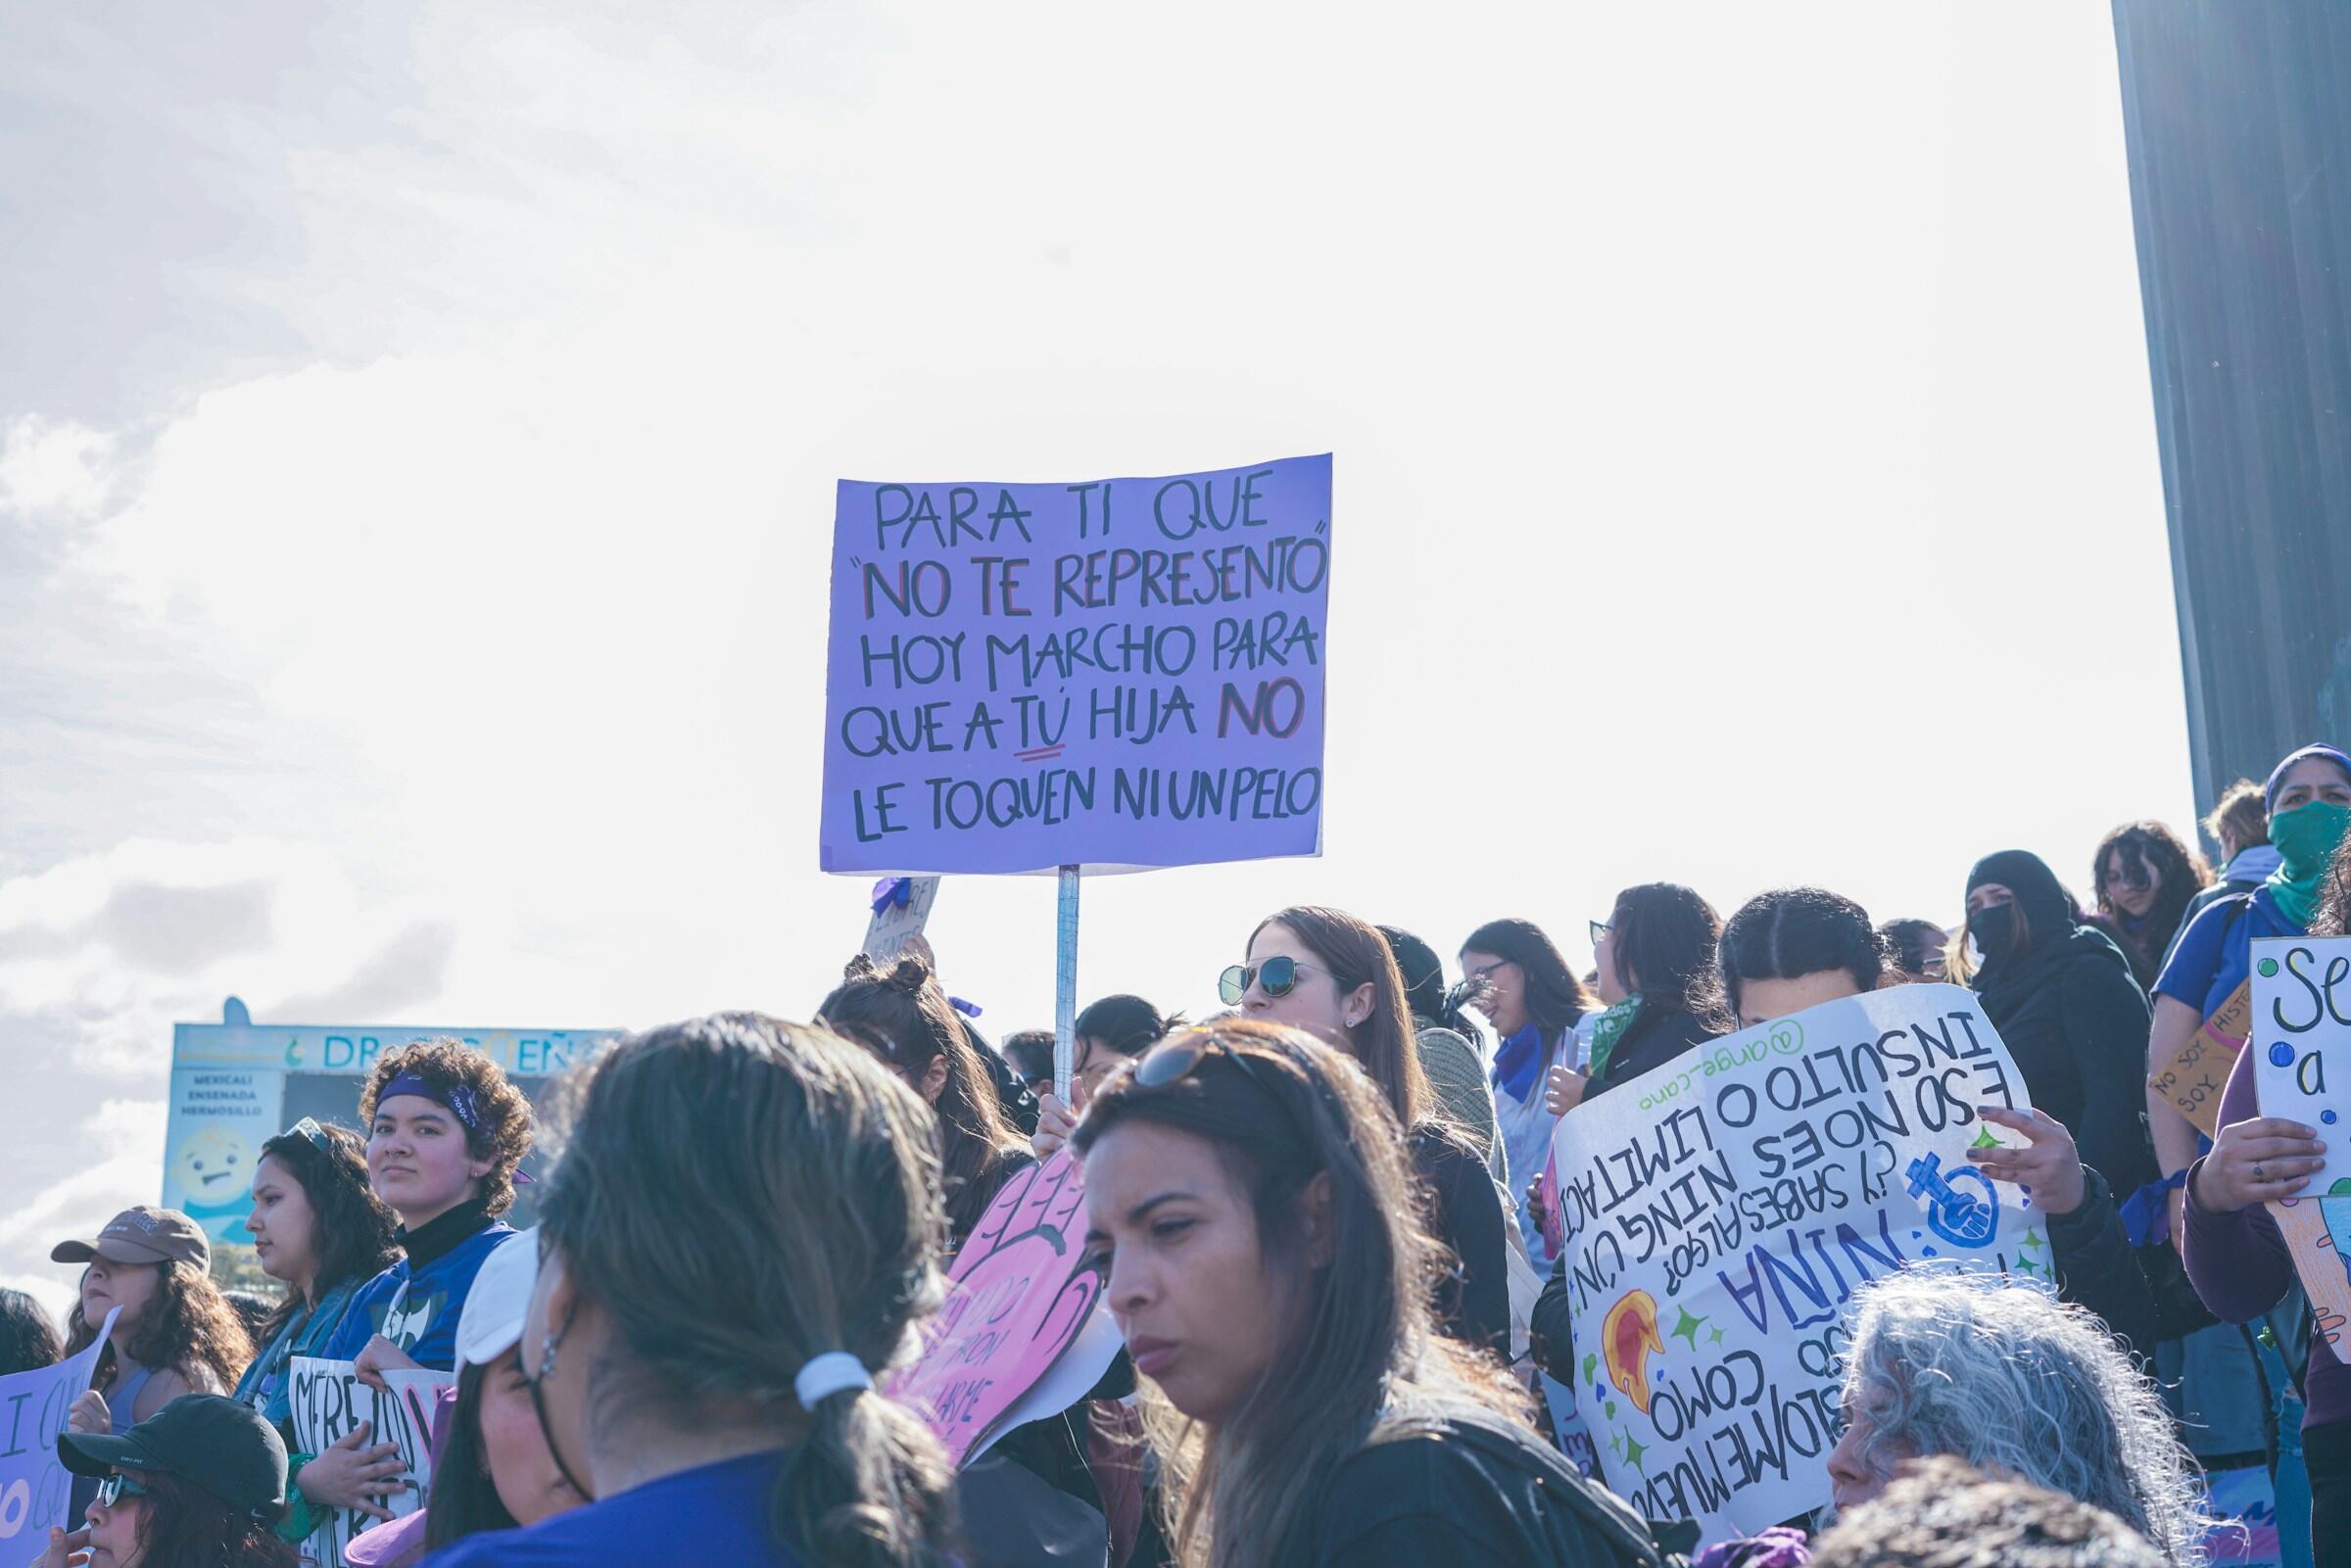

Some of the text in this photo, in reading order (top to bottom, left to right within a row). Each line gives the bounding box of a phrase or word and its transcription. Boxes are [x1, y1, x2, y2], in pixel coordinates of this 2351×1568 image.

[875, 469, 1273, 550] PARA TI QUE
[970, 555, 1032, 617] TE
[861, 610, 1319, 691] HOY MARCHO PARA
[840, 676, 1306, 758] QUE A TÚ HIJA NO
[853, 783, 908, 842] LE
[925, 767, 1096, 830] TOQUEN
[1765, 1012, 1992, 1112] INSULTO
[2178, 1039, 2208, 1069] SOY
[2213, 983, 2251, 1031] HISTE
[188, 1089, 258, 1101] ENSENADA
[193, 1074, 254, 1086] MEXICALI
[1639, 1019, 1804, 1111] @ange_cano
[1915, 1060, 2015, 1133] ESO
[2178, 1073, 2219, 1113] SOY
[2296, 1049, 2327, 1095] a
[181, 1106, 263, 1117] HERMOSILLO
[1716, 1083, 1757, 1128] O
[1824, 1089, 1911, 1150] NO
[1752, 1119, 1824, 1179] ES
[1739, 1163, 1849, 1233] SABES
[1662, 1201, 1743, 1298] ALGO?
[1715, 1208, 1908, 1336] NIÑA
[1650, 1350, 1765, 1443] COMO
